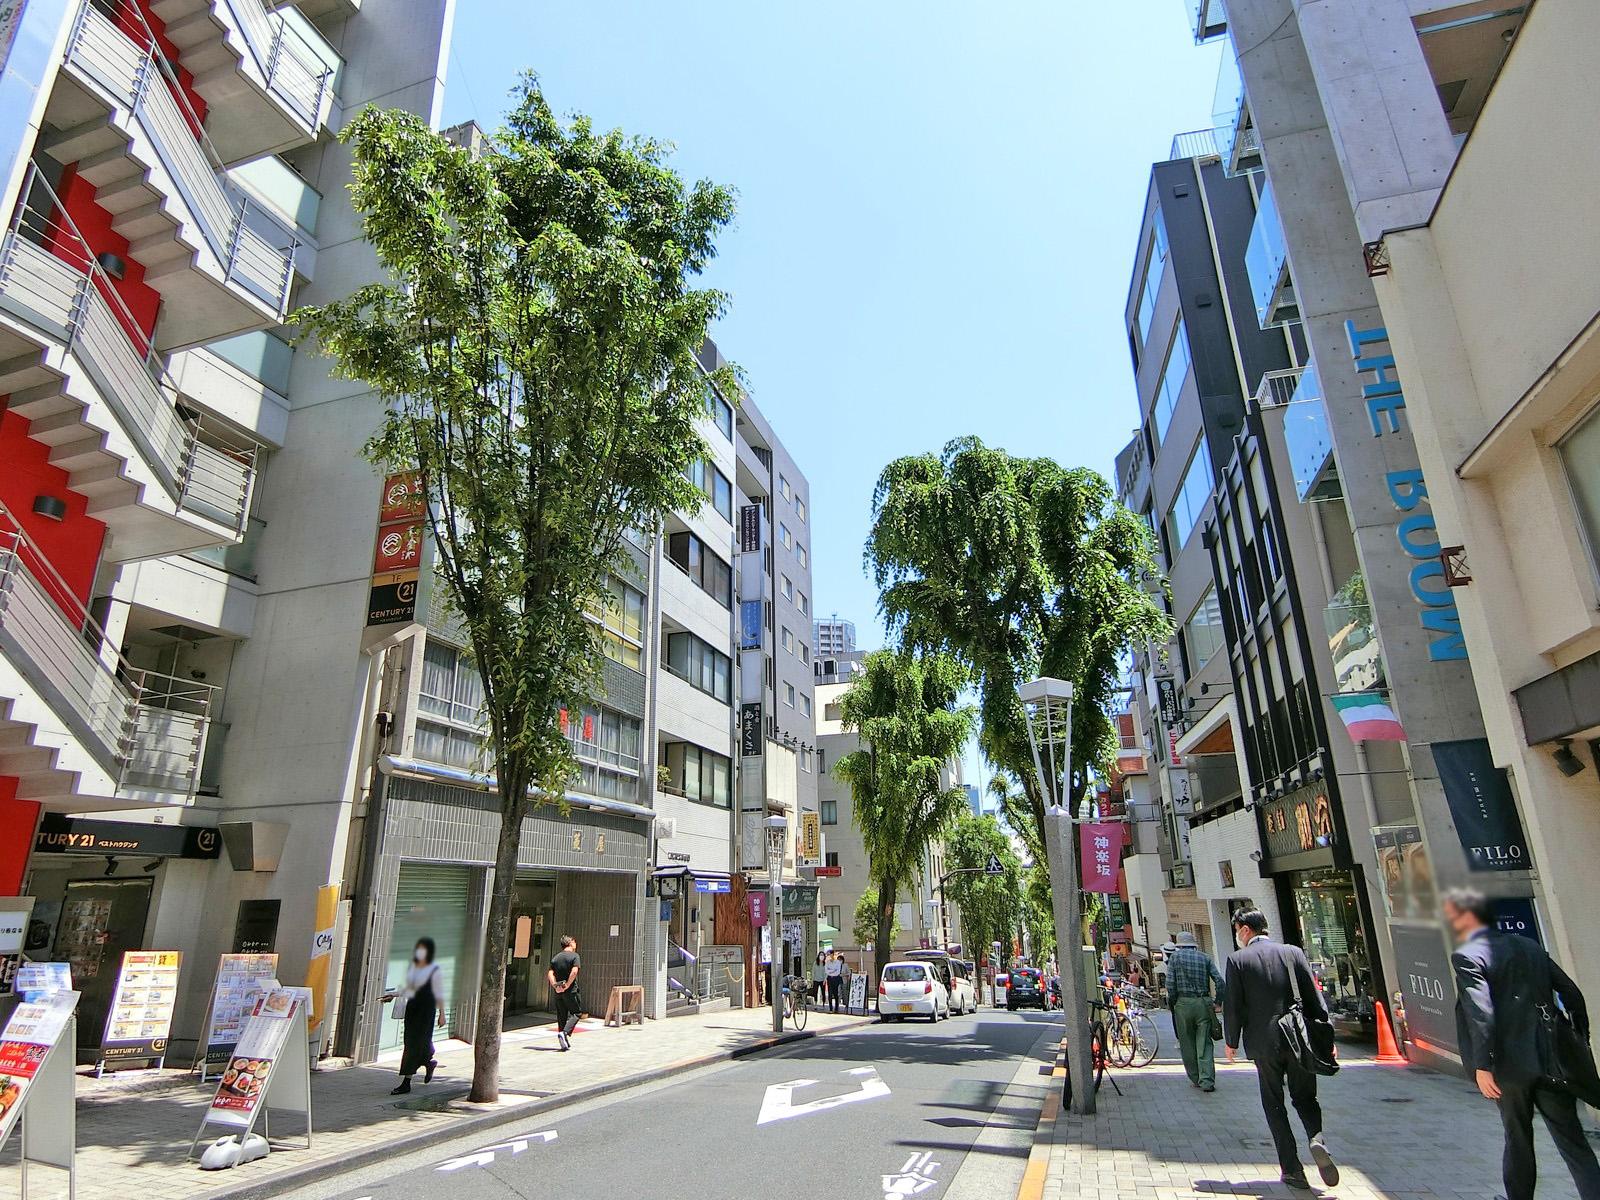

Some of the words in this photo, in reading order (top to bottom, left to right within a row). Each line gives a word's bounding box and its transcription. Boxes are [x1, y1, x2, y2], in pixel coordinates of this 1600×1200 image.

[370, 608, 404, 619] CENTURY
[406, 606, 414, 614] 21
[37, 832, 79, 846] TURY
[80, 833, 95, 847] 21
[1094, 836, 1111, 876] 神楽坂
[1471, 844, 1521, 860] FILO
[1496, 920, 1526, 930] ILO
[1409, 974, 1444, 1000] FILO
